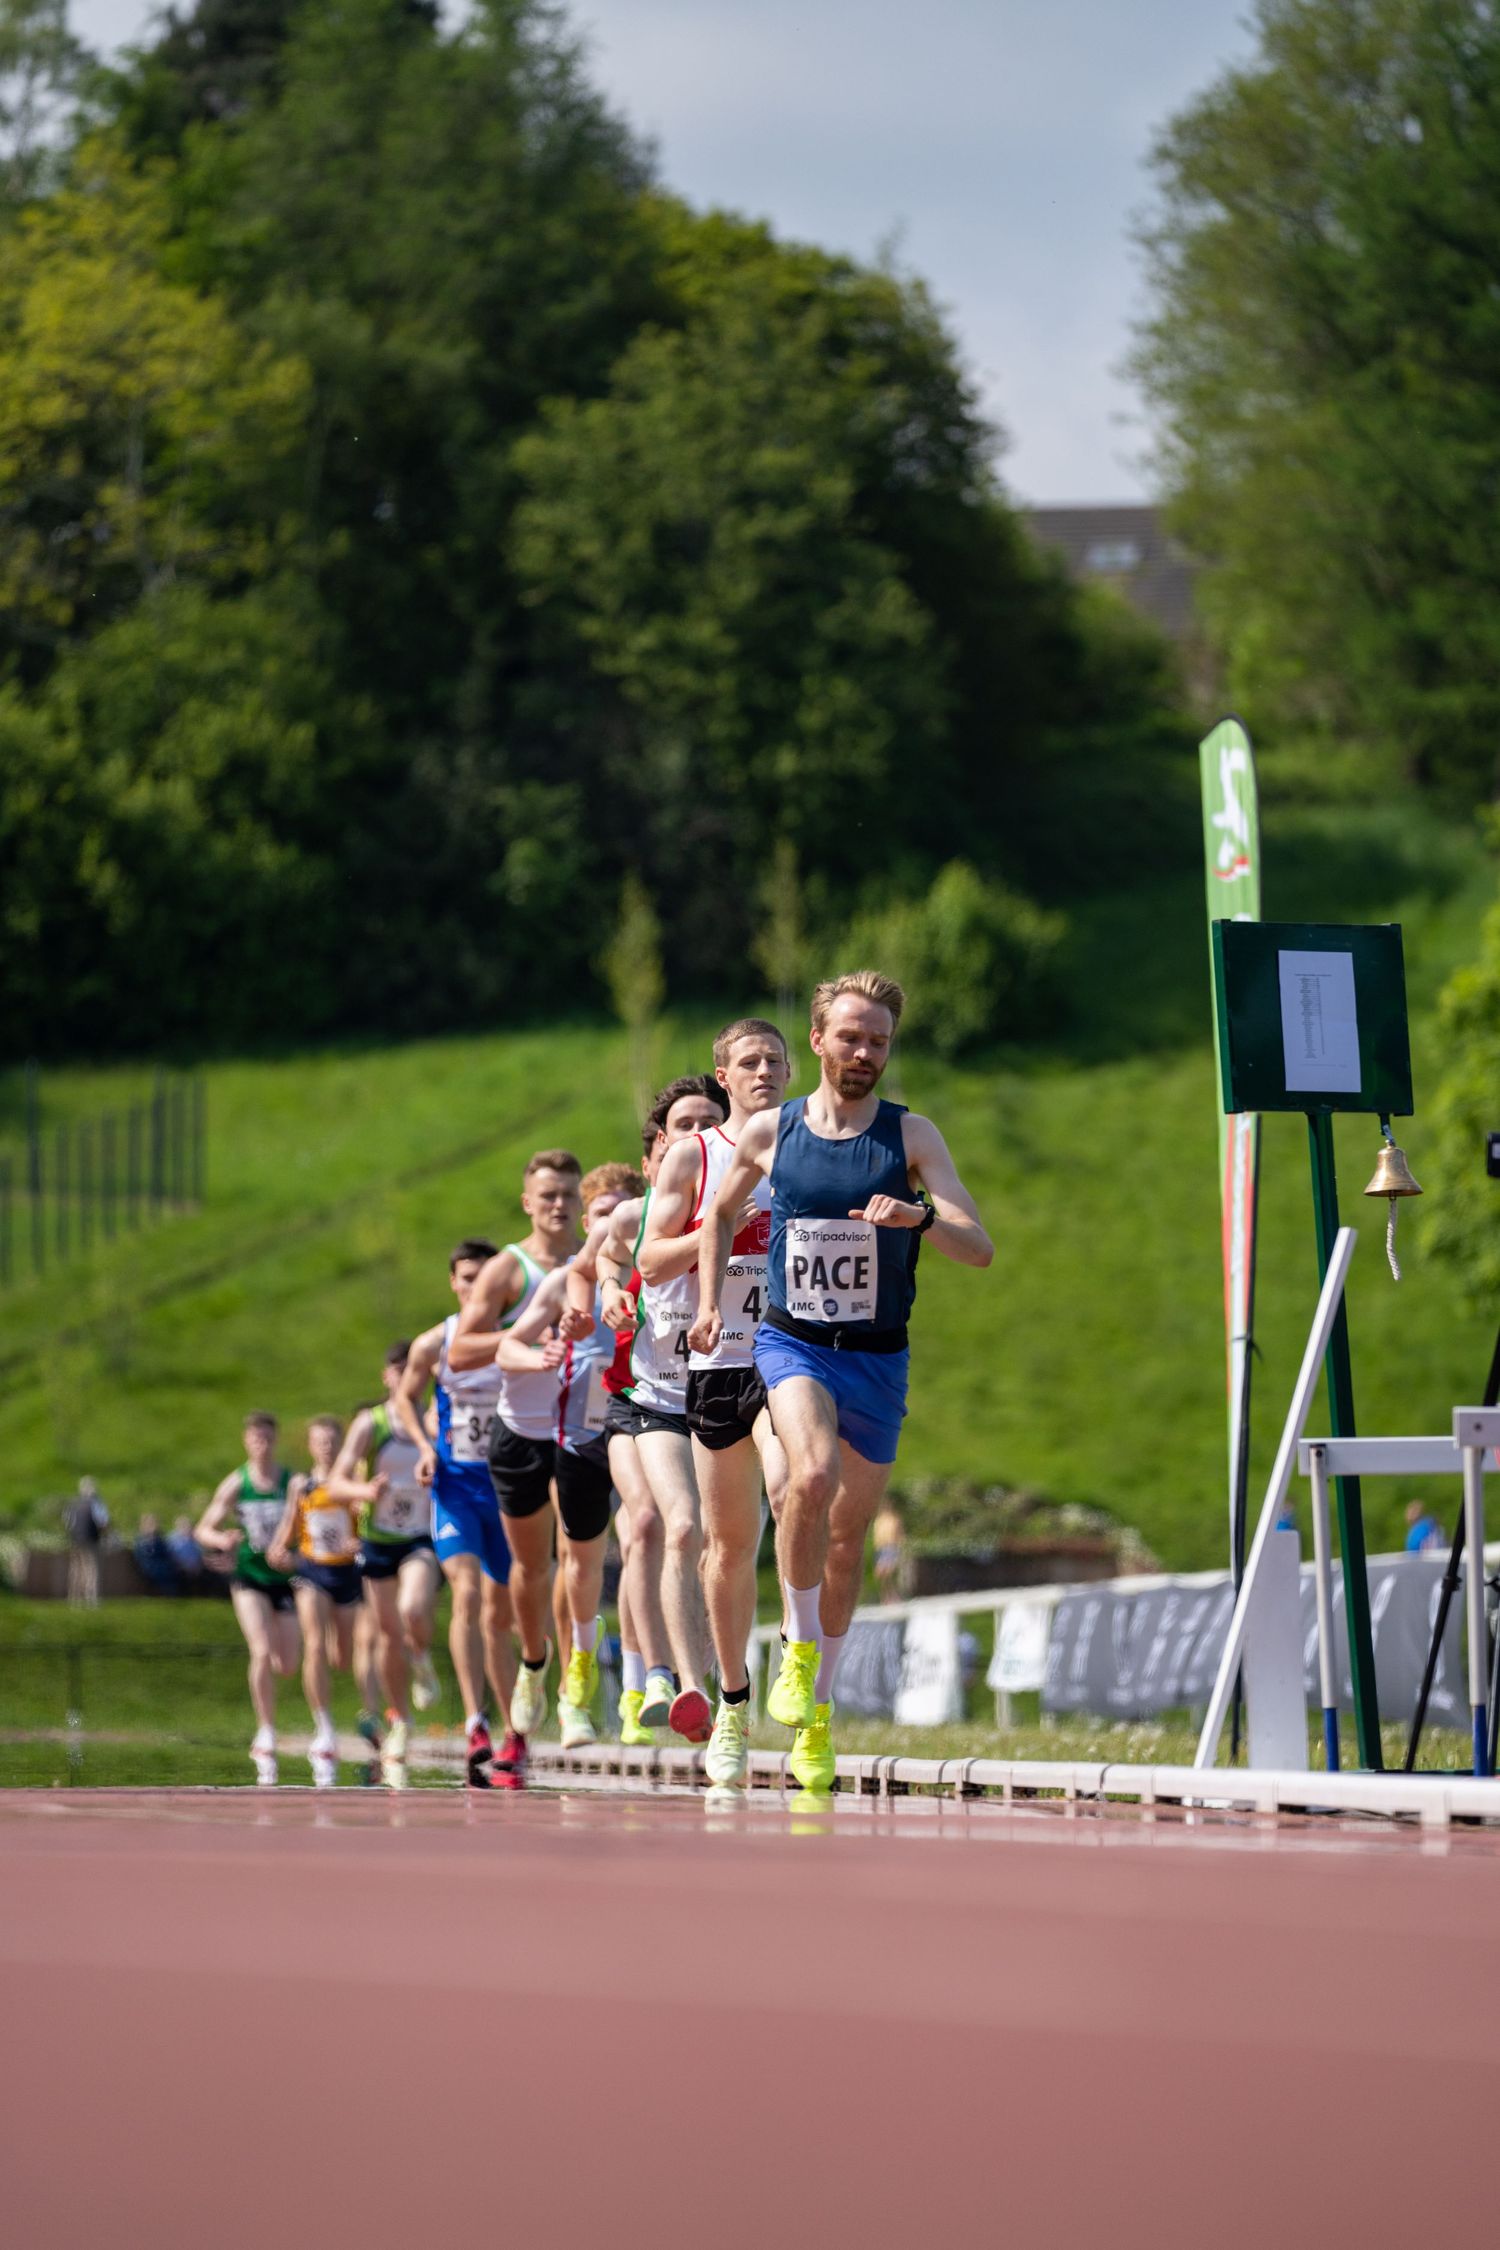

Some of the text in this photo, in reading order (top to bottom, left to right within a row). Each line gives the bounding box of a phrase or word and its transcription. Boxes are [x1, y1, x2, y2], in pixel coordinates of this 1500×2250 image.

[811, 1231, 871, 1243] Tripadvisor
[793, 1255, 870, 1290] PACE
[742, 1286, 768, 1323] 4
[791, 1302, 815, 1311] IMC
[722, 1332, 744, 1340] IMC
[659, 1372, 678, 1380] IMC
